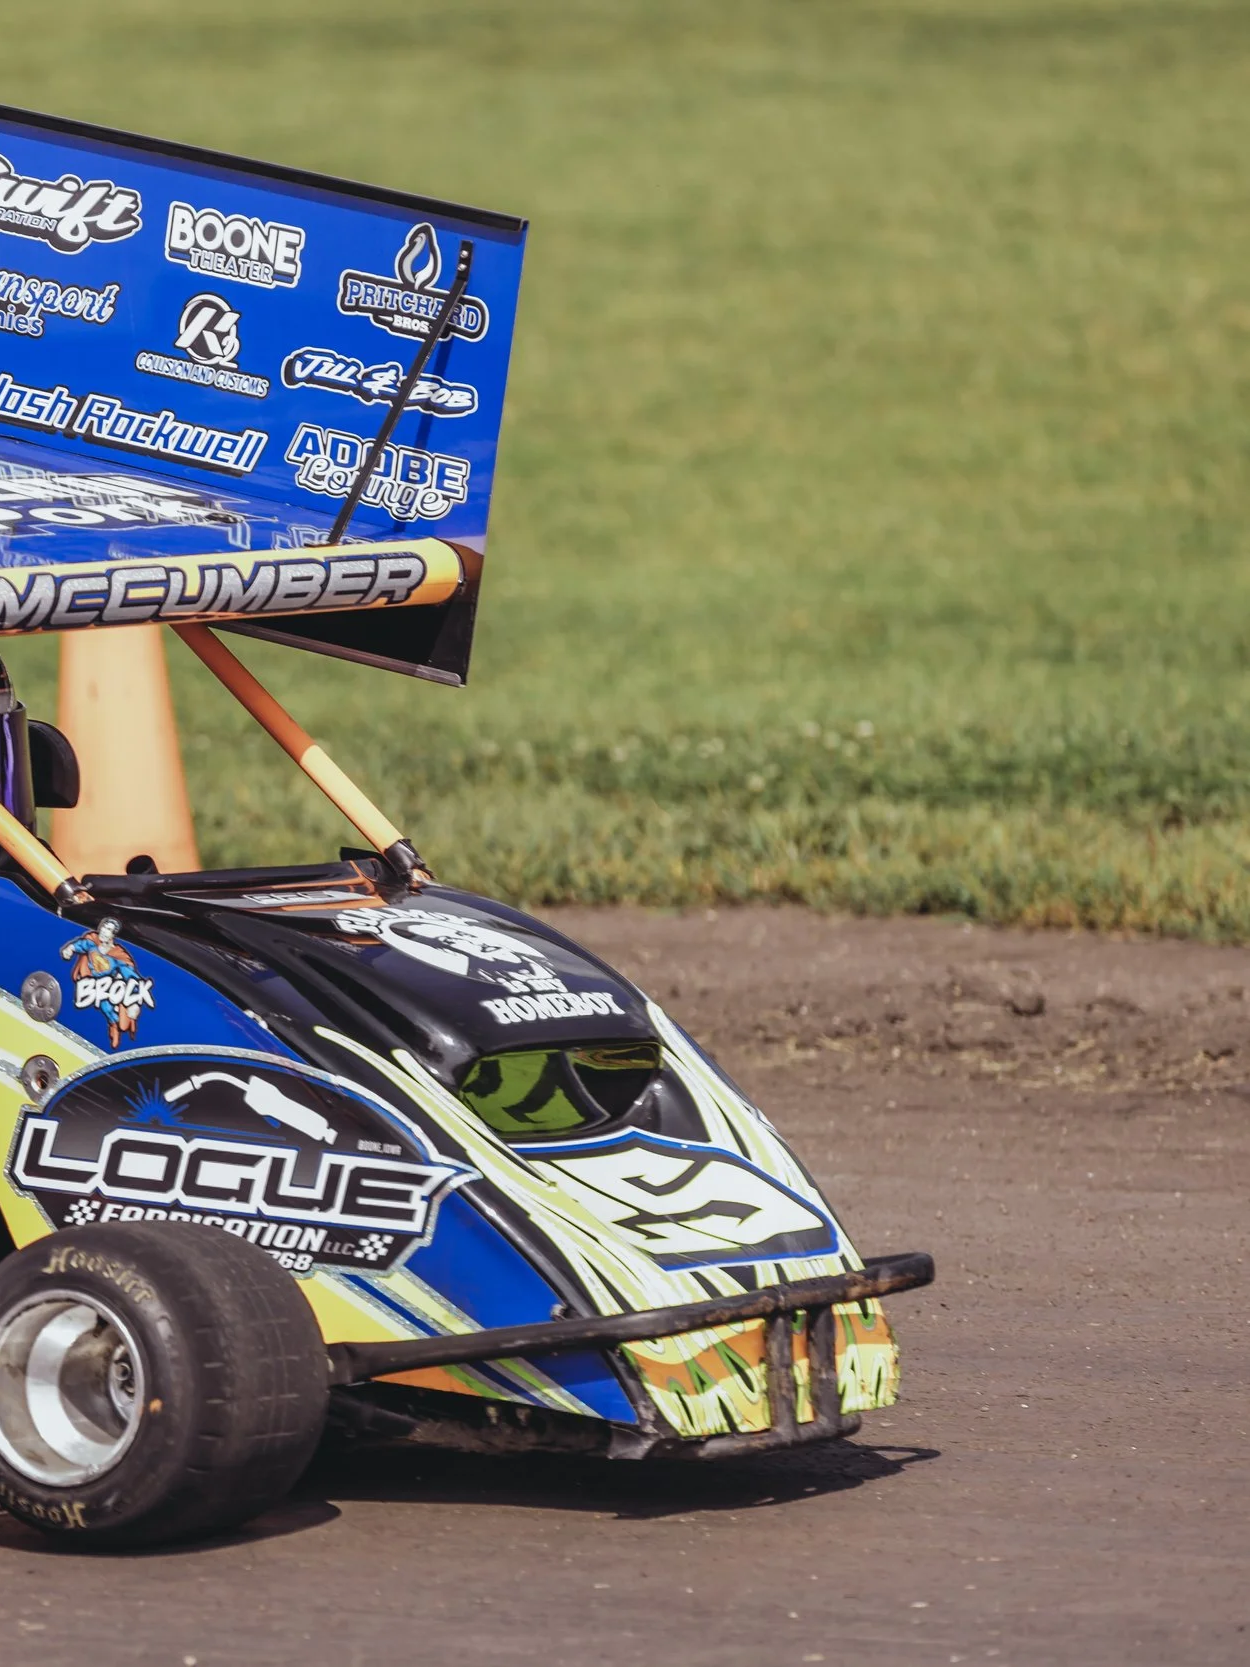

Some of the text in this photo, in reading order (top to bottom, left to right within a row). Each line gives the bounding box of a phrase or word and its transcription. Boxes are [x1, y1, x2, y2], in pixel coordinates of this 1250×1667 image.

[170, 204, 303, 275] BOONE
[189, 249, 275, 285] THEATER
[136, 351, 270, 398] COLLISION AND CUSTOMS
[362, 368, 400, 396] &
[73, 394, 269, 472] Rockwell
[288, 426, 465, 499] ADOBE
[299, 457, 451, 519] Lounge
[73, 975, 155, 1010] BROCK
[503, 976, 569, 995] is my
[480, 991, 627, 1026] HOMEBOY
[17, 1118, 450, 1229] LOGUE
[323, 1241, 356, 1256] LLC
